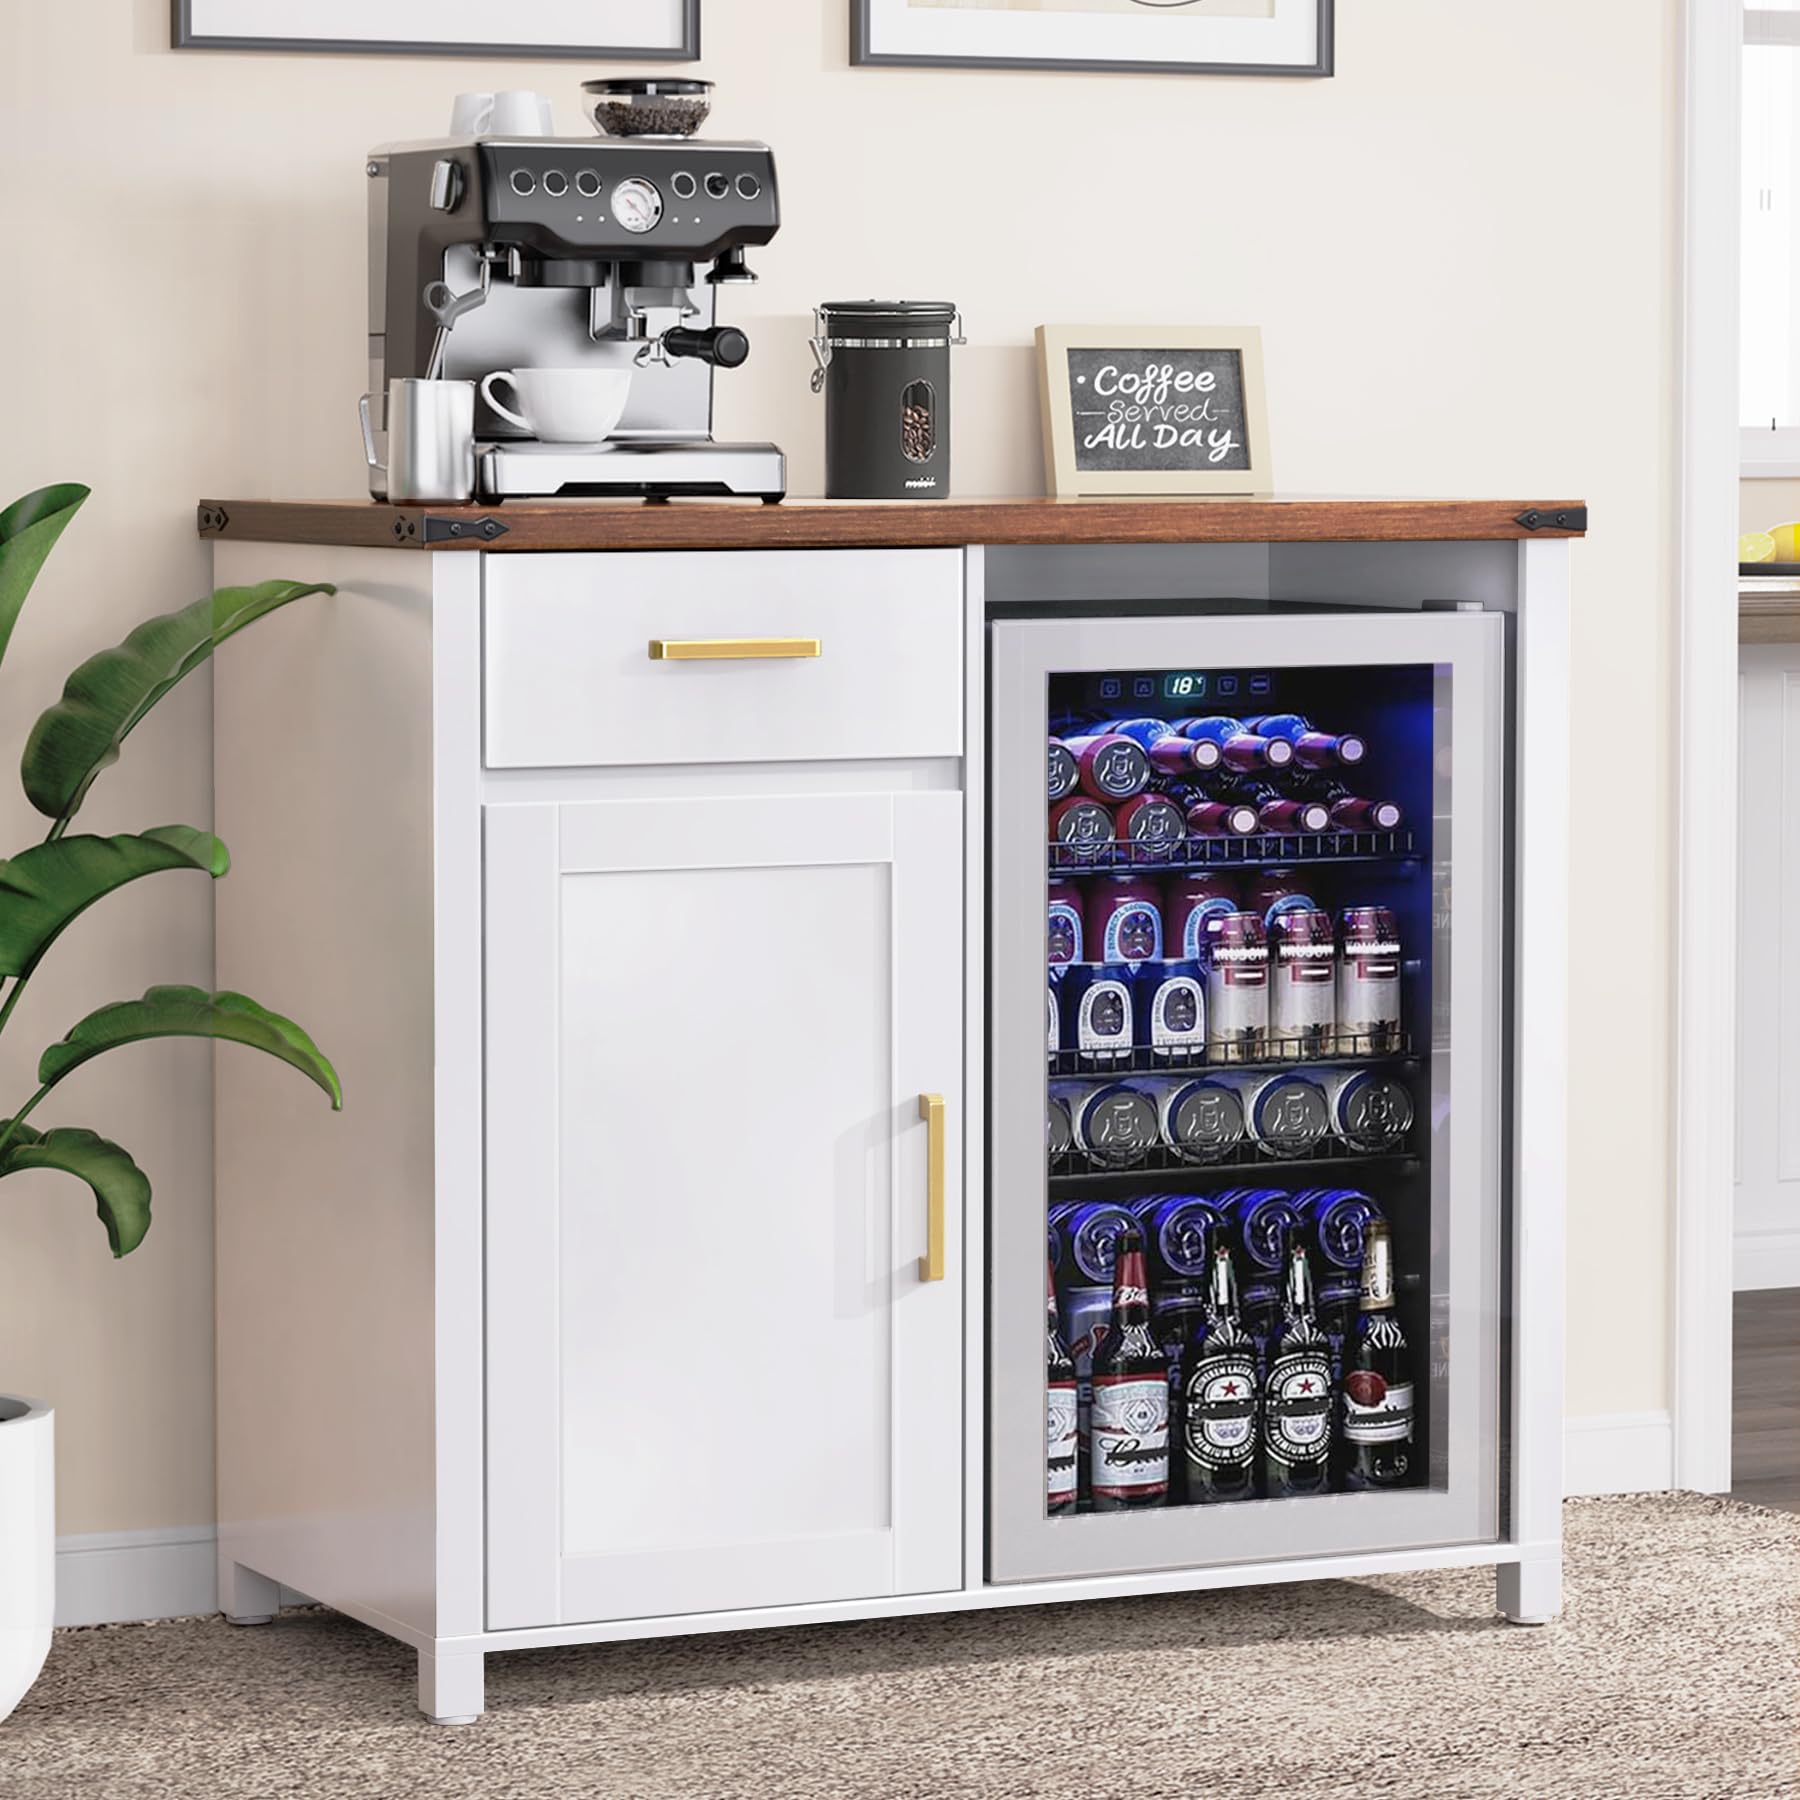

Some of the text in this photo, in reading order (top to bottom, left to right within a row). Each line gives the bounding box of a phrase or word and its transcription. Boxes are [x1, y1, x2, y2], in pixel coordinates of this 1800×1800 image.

[1094, 364, 1216, 405] Coffee
[1107, 398, 1218, 424] Served
[1083, 424, 1240, 462] All Day
